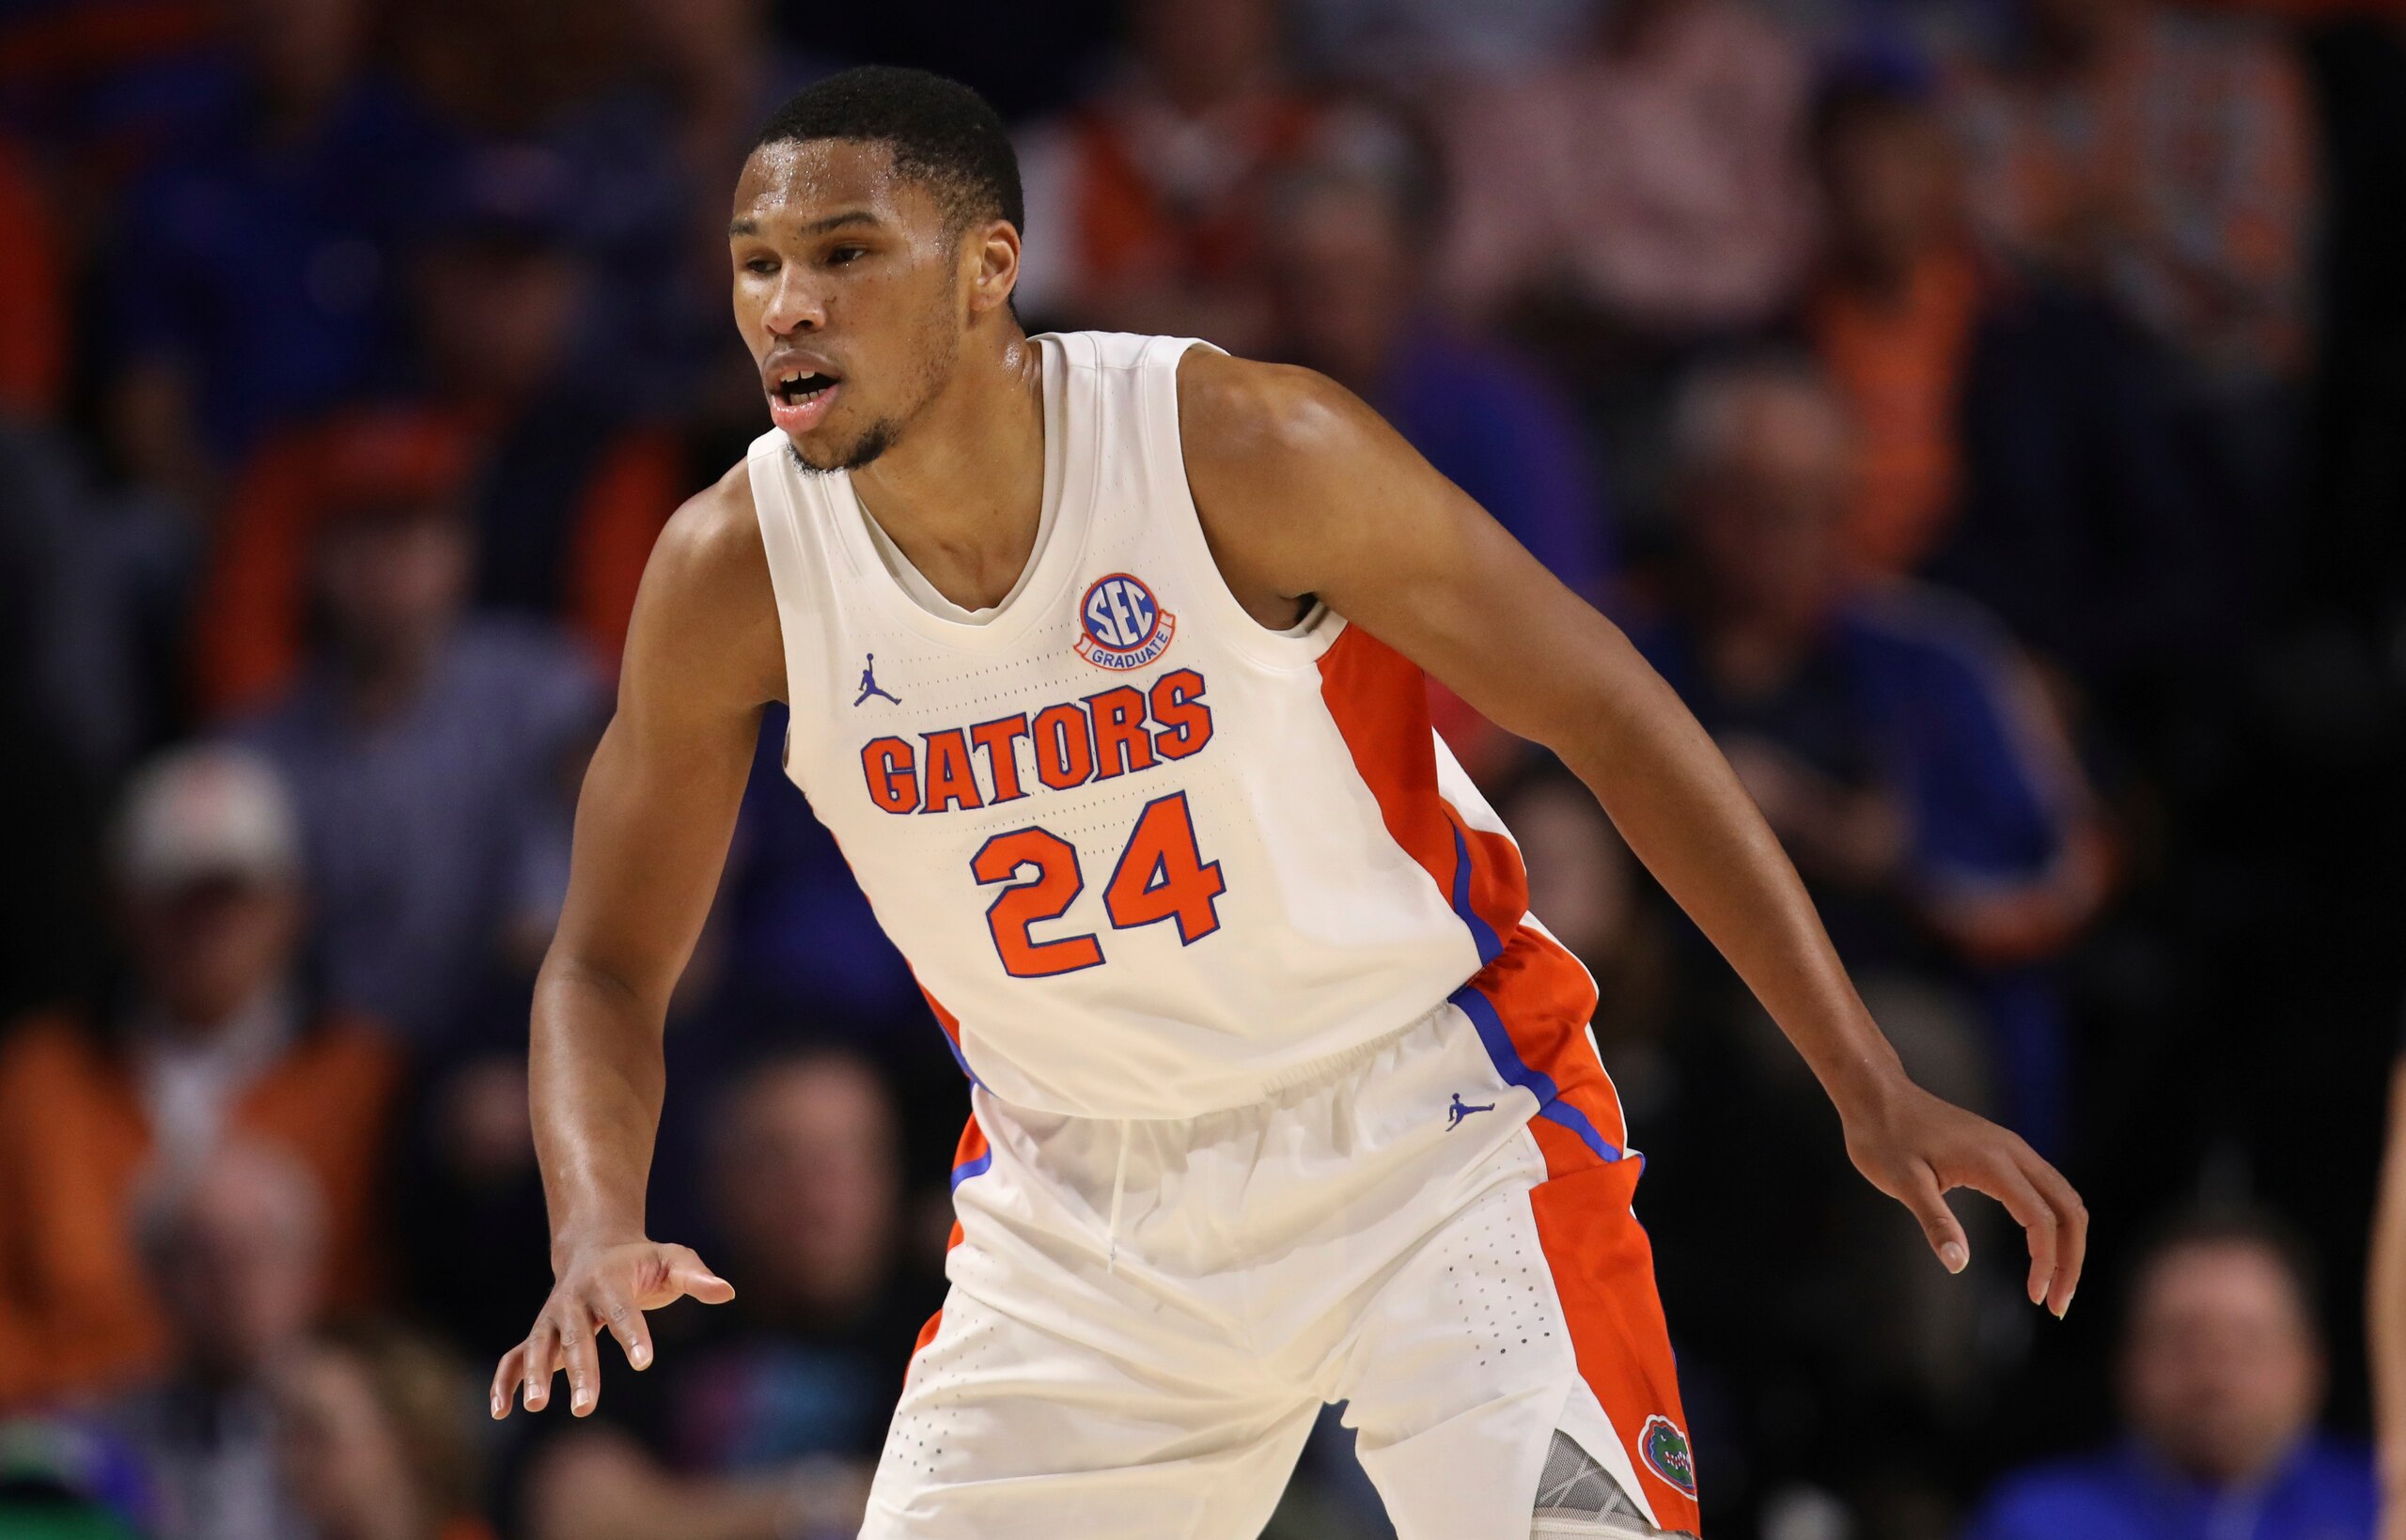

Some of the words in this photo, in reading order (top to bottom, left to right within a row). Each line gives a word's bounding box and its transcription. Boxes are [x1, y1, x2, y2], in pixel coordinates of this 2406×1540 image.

[1087, 580, 1153, 646] SEC
[1091, 630, 1168, 668] GRADUATE
[860, 668, 1214, 815] GATORS
[969, 789, 1227, 978] 24
